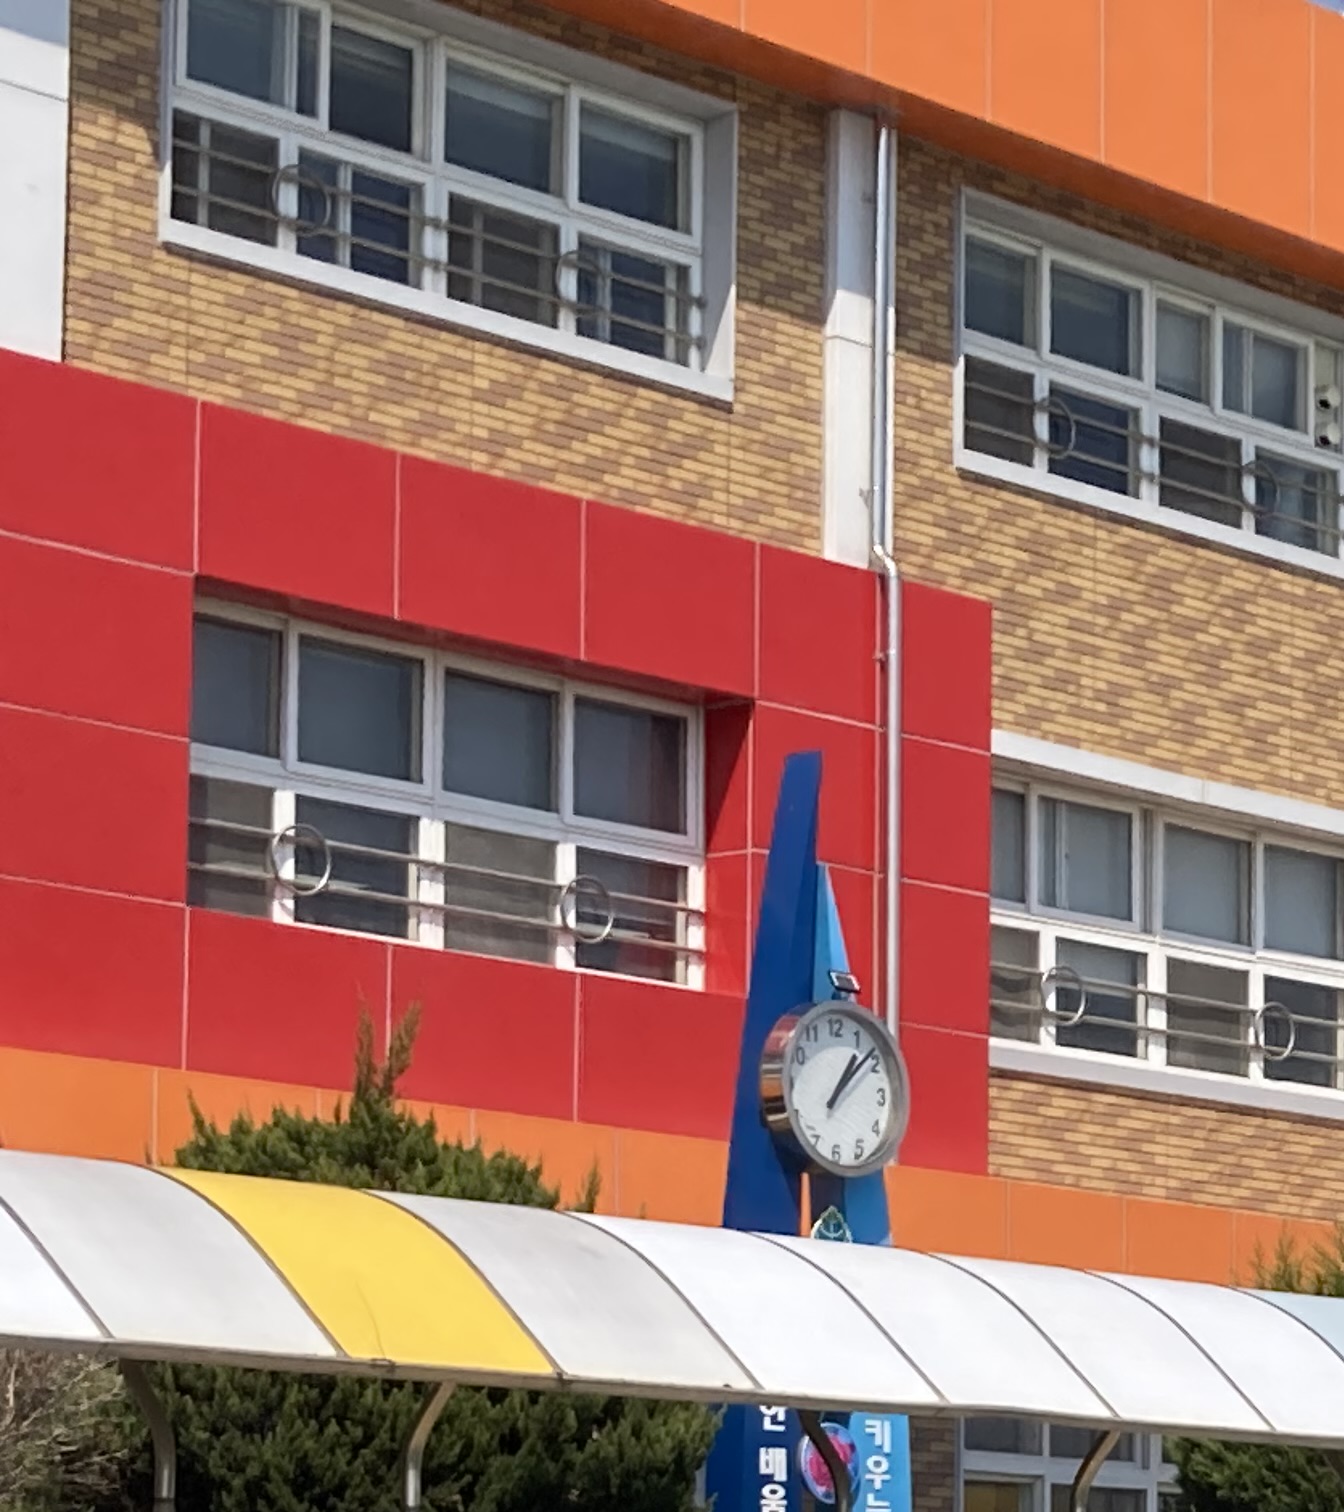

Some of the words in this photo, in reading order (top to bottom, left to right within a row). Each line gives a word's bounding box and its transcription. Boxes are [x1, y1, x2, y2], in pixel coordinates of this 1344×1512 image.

[805, 1025, 819, 1043] 11
[827, 1018, 844, 1038] 12
[853, 1030, 861, 1049] 1
[871, 1055, 881, 1074] 2
[876, 1088, 886, 1107] 3
[871, 1119, 881, 1137] 4
[831, 1144, 841, 1164] 6
[854, 1139, 865, 1160] 5
